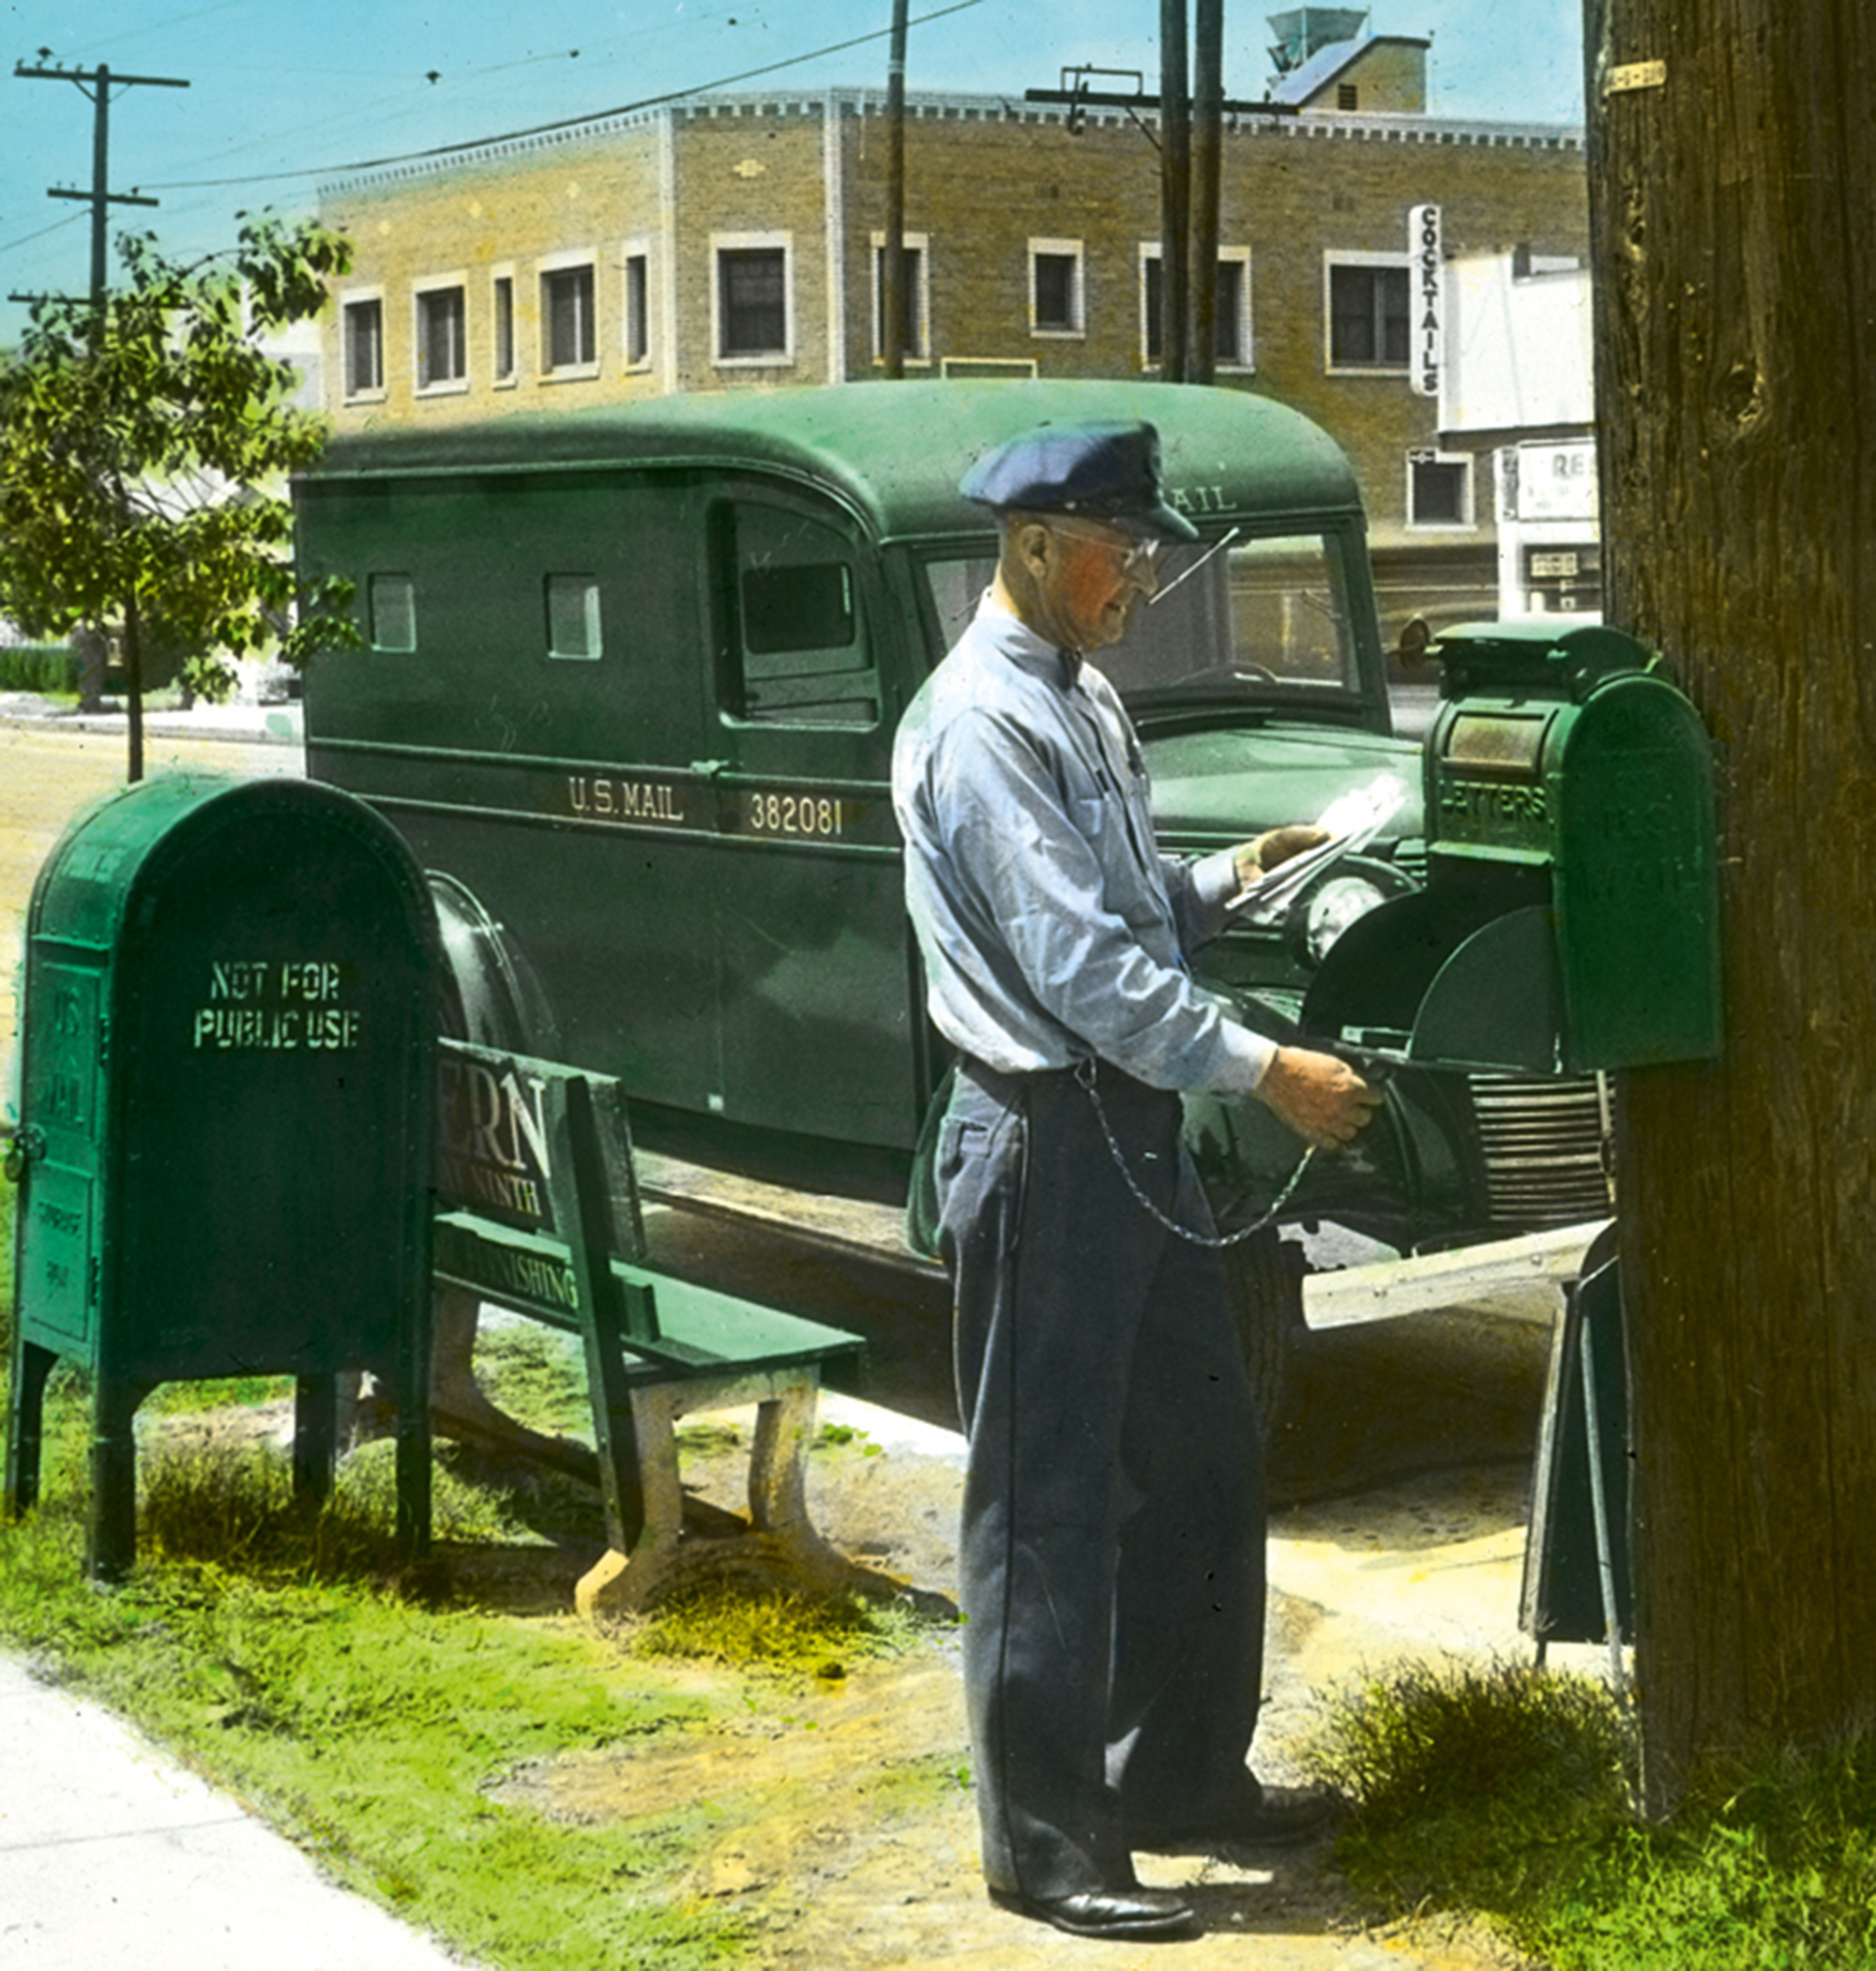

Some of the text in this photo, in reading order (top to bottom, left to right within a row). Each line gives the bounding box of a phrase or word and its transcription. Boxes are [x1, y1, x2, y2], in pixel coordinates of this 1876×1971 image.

[1421, 207, 1439, 391] COCKTAILS
[1170, 486, 1236, 511] AIL
[751, 794, 841, 835] 382081
[1438, 779, 1548, 823] LETTERS
[211, 962, 339, 1000] NOT FOR
[194, 1009, 360, 1049] PUBLIC USE
[468, 1164, 542, 1216] NINTH
